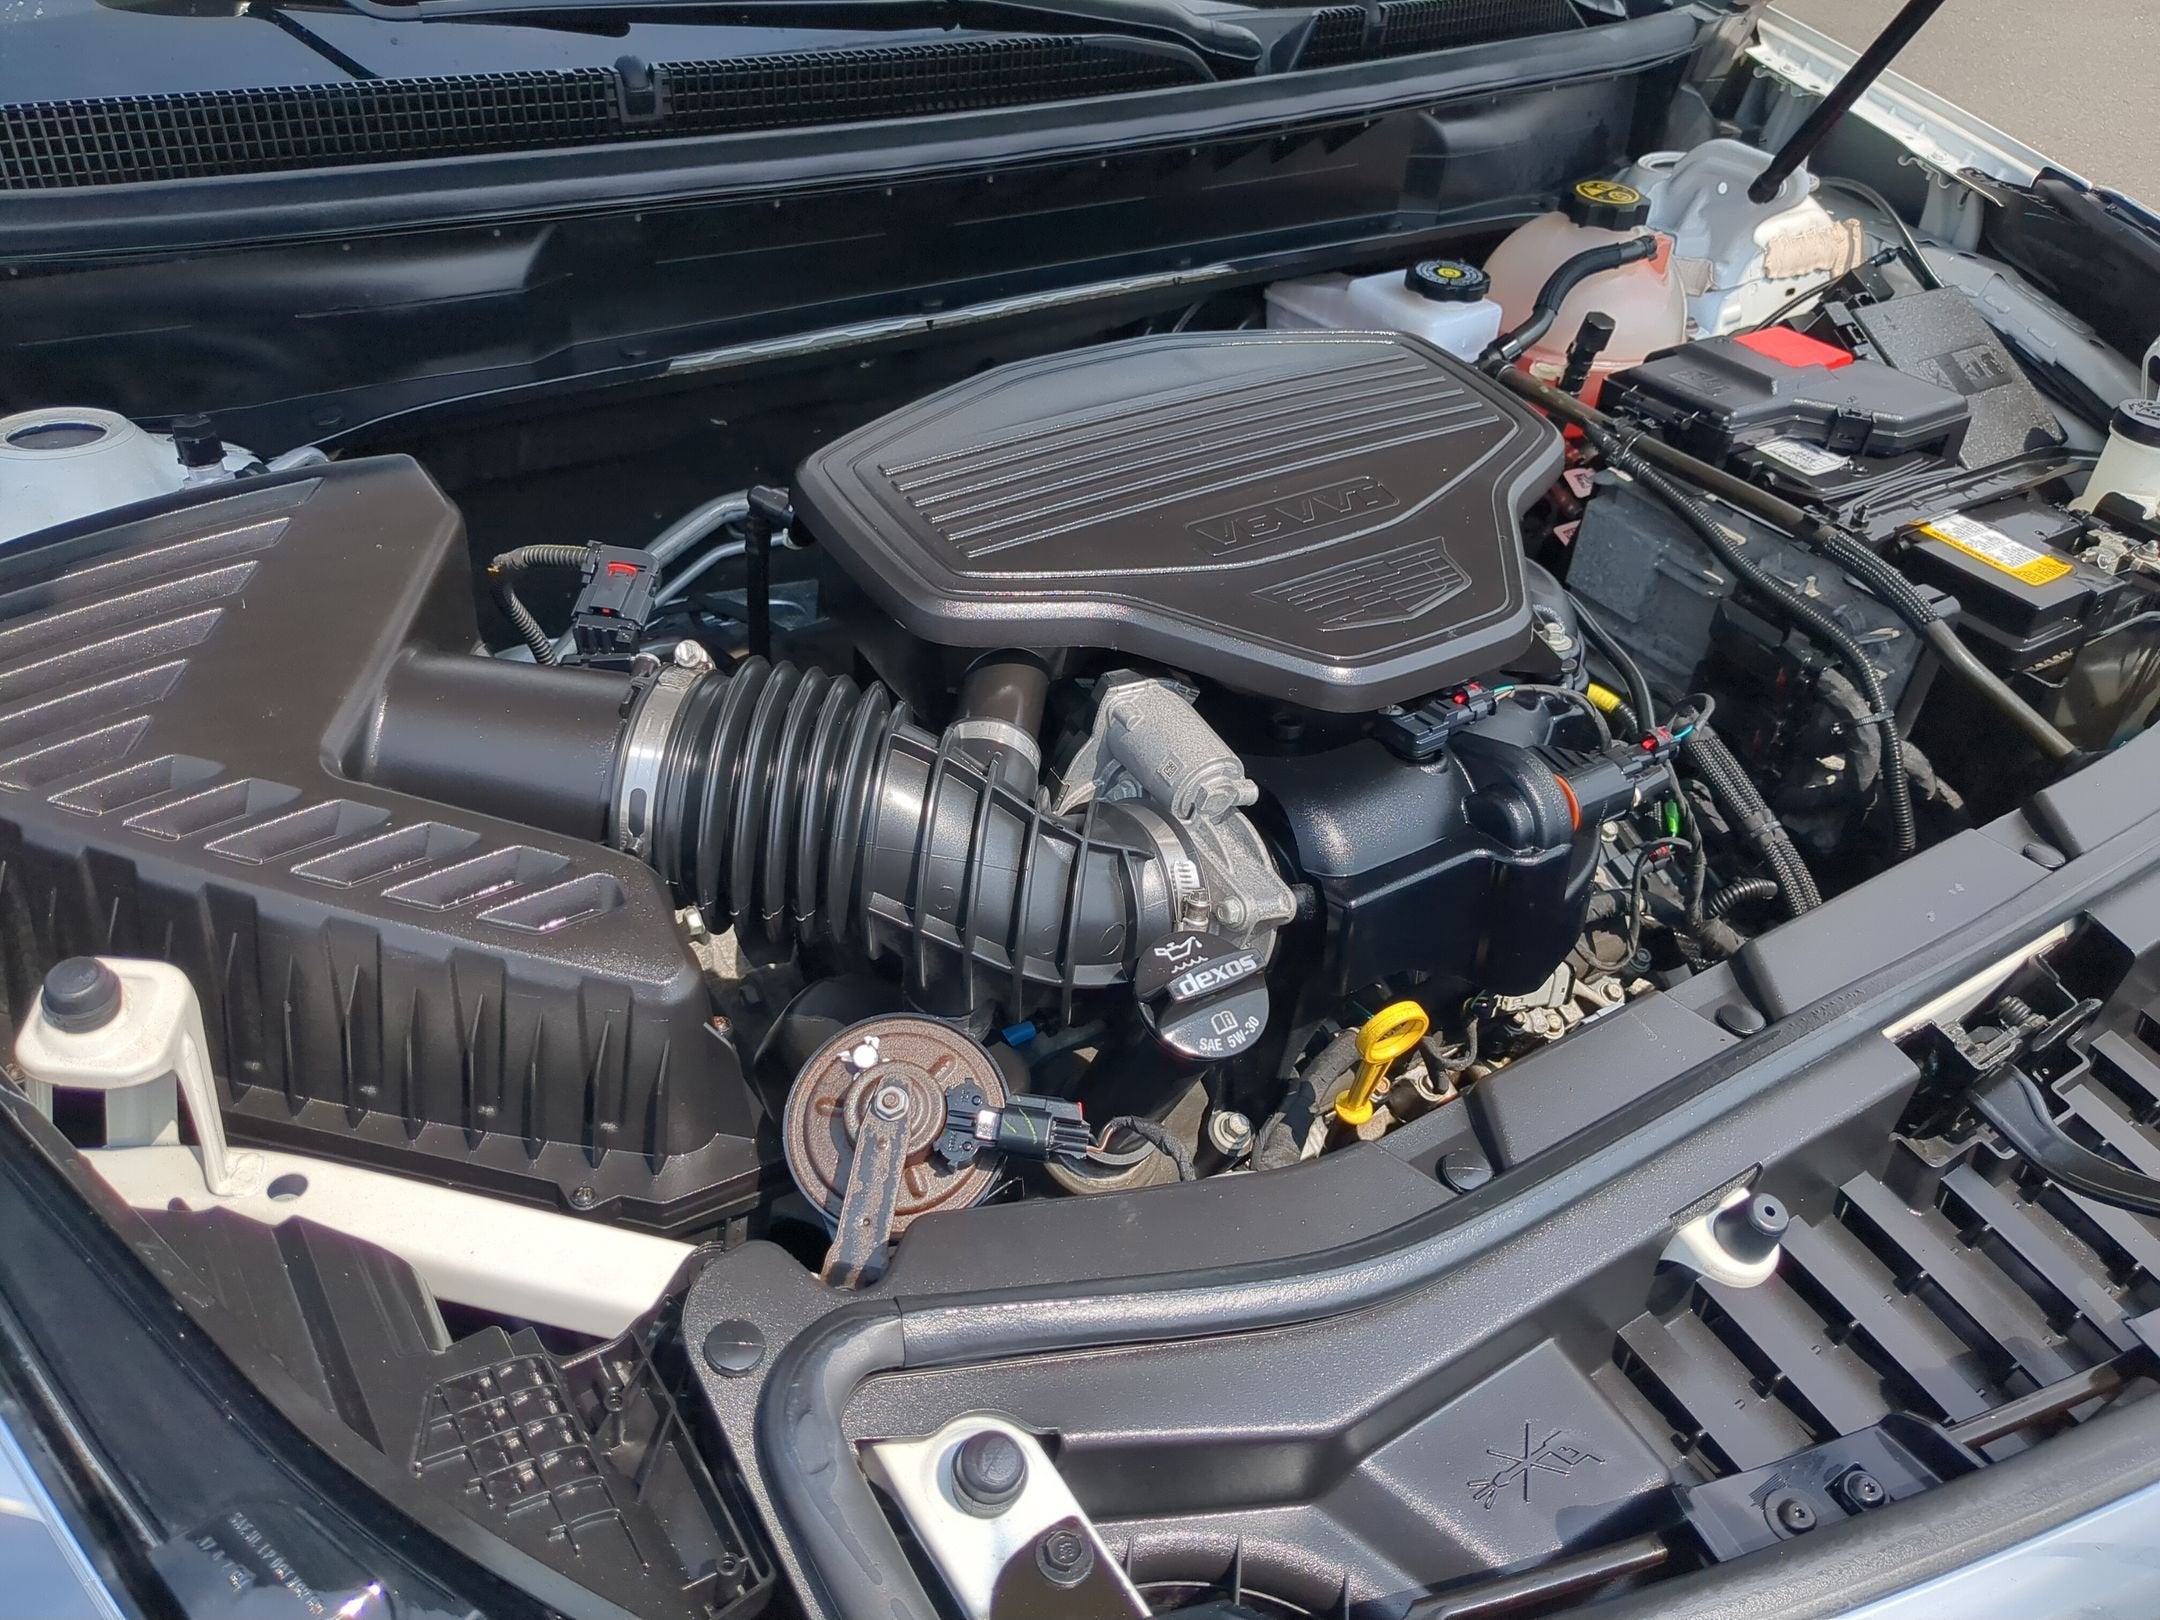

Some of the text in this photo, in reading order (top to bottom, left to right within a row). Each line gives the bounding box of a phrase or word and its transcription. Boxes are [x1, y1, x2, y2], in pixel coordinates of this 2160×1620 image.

[1179, 954, 1256, 995] dexos
[1199, 1016, 1259, 1051] SAE 5W-30
